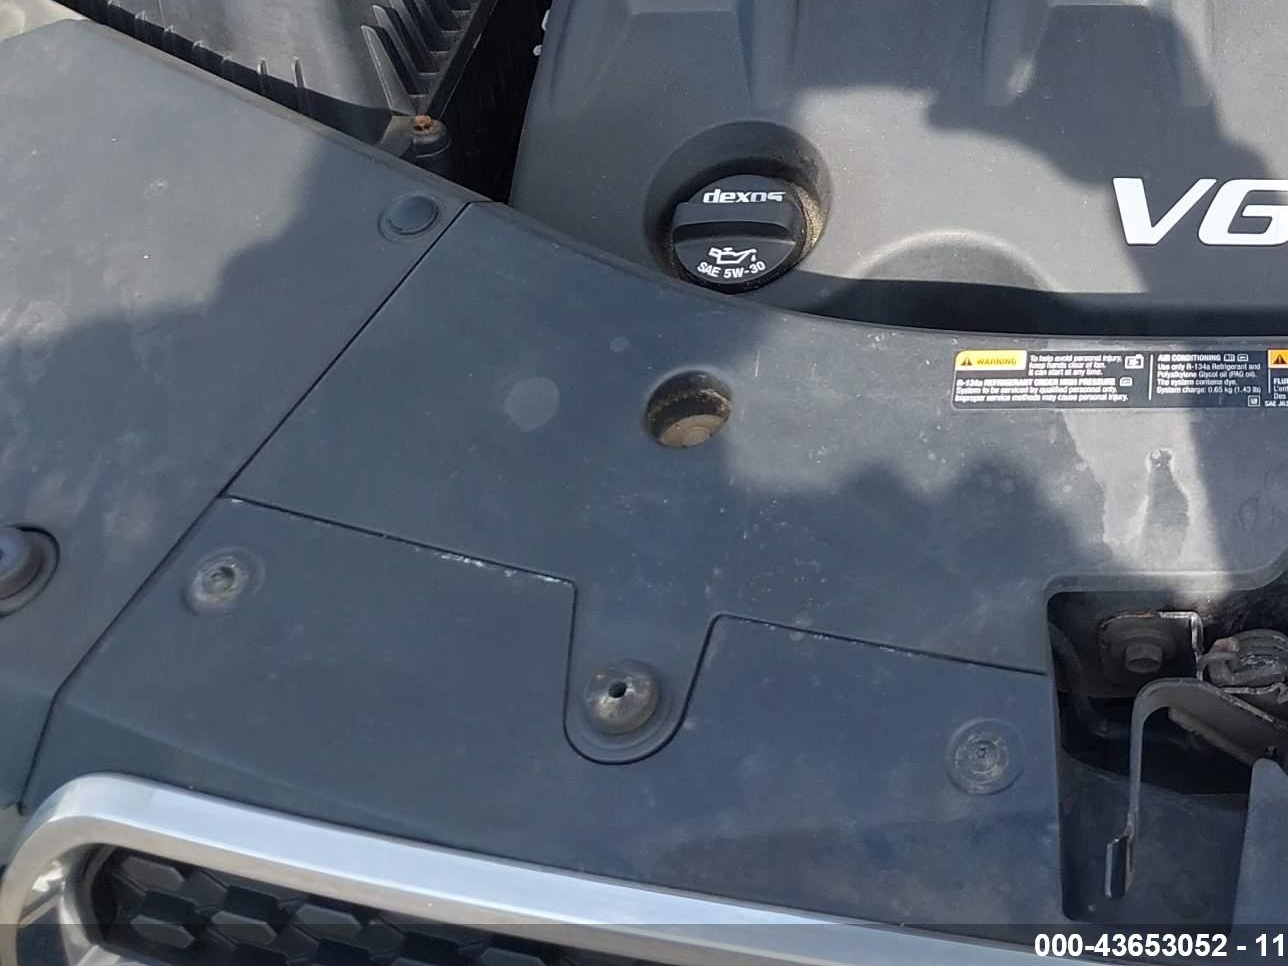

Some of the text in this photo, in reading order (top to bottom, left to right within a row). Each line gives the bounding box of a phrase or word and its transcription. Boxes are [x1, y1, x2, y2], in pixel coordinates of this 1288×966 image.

[703, 189, 786, 204] dexos
[697, 261, 766, 278] SAE 5W-30
[977, 358, 1017, 366] WARNING
[1158, 354, 1222, 362] AIR CONDITIONING
[1158, 363, 1260, 371] Use only R-134a Refrigerant and
